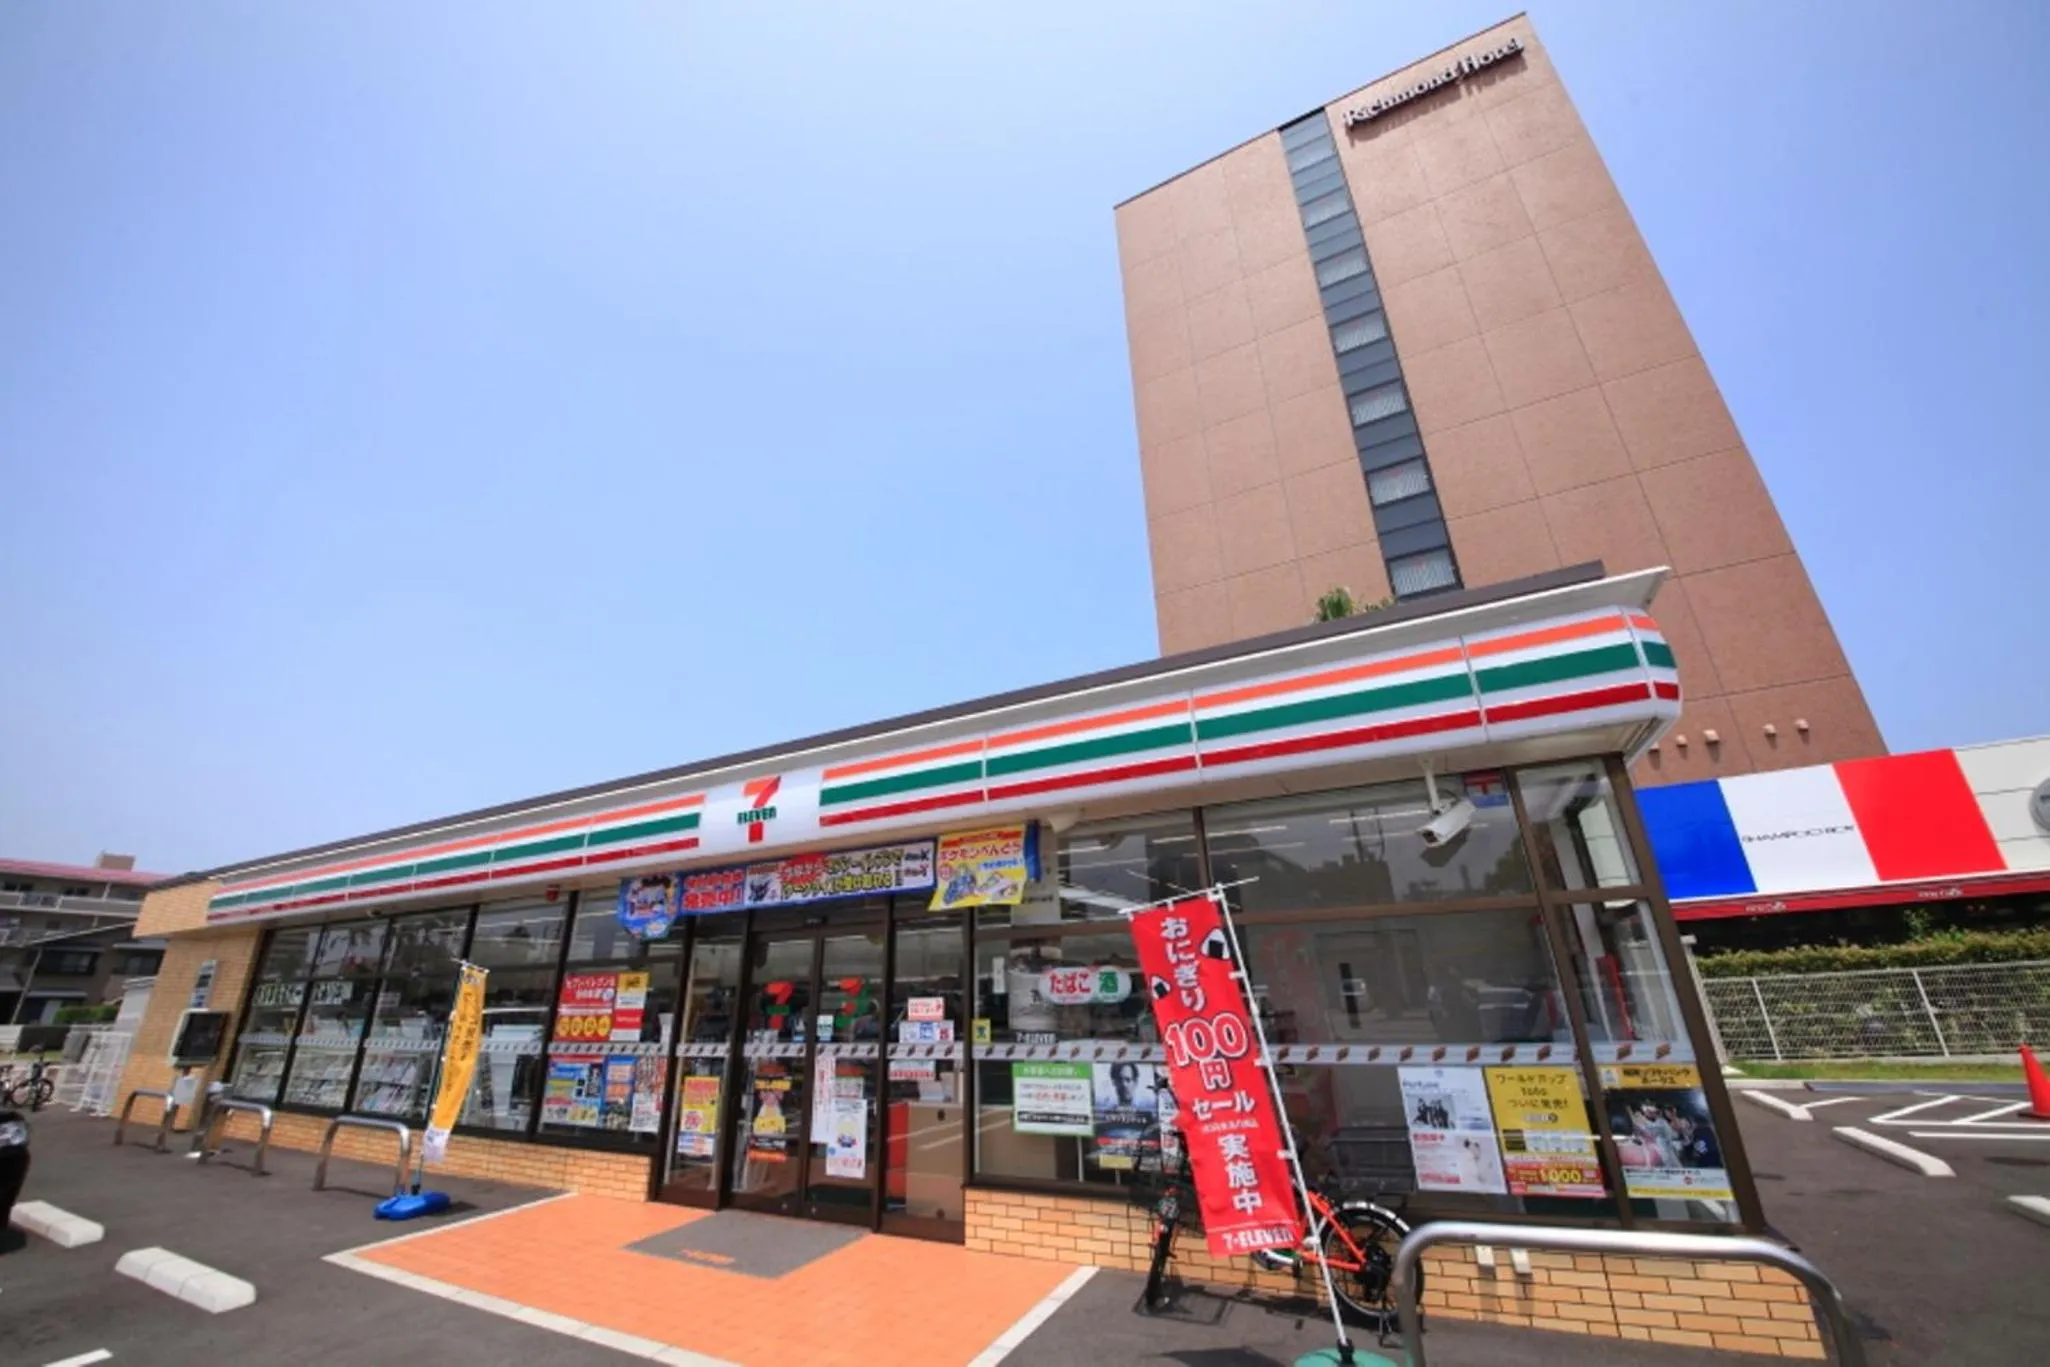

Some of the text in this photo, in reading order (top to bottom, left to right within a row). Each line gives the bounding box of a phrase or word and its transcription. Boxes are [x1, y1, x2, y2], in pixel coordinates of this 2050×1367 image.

[1341, 37, 1526, 128] Richmond Hotel
[737, 806, 777, 825] ELEVEN
[744, 776, 781, 843] 7
[1160, 916, 1206, 1012] おにぎり
[1049, 970, 1092, 994] たばこ
[1164, 1012, 1248, 1066] 100
[1201, 1058, 1232, 1091] 円
[1496, 1073, 1567, 1085] ワールドカップ
[1192, 1090, 1256, 1121] セール
[1218, 1133, 1264, 1216] 実施中
[1222, 1226, 1295, 1250] 7-ELEVEN
